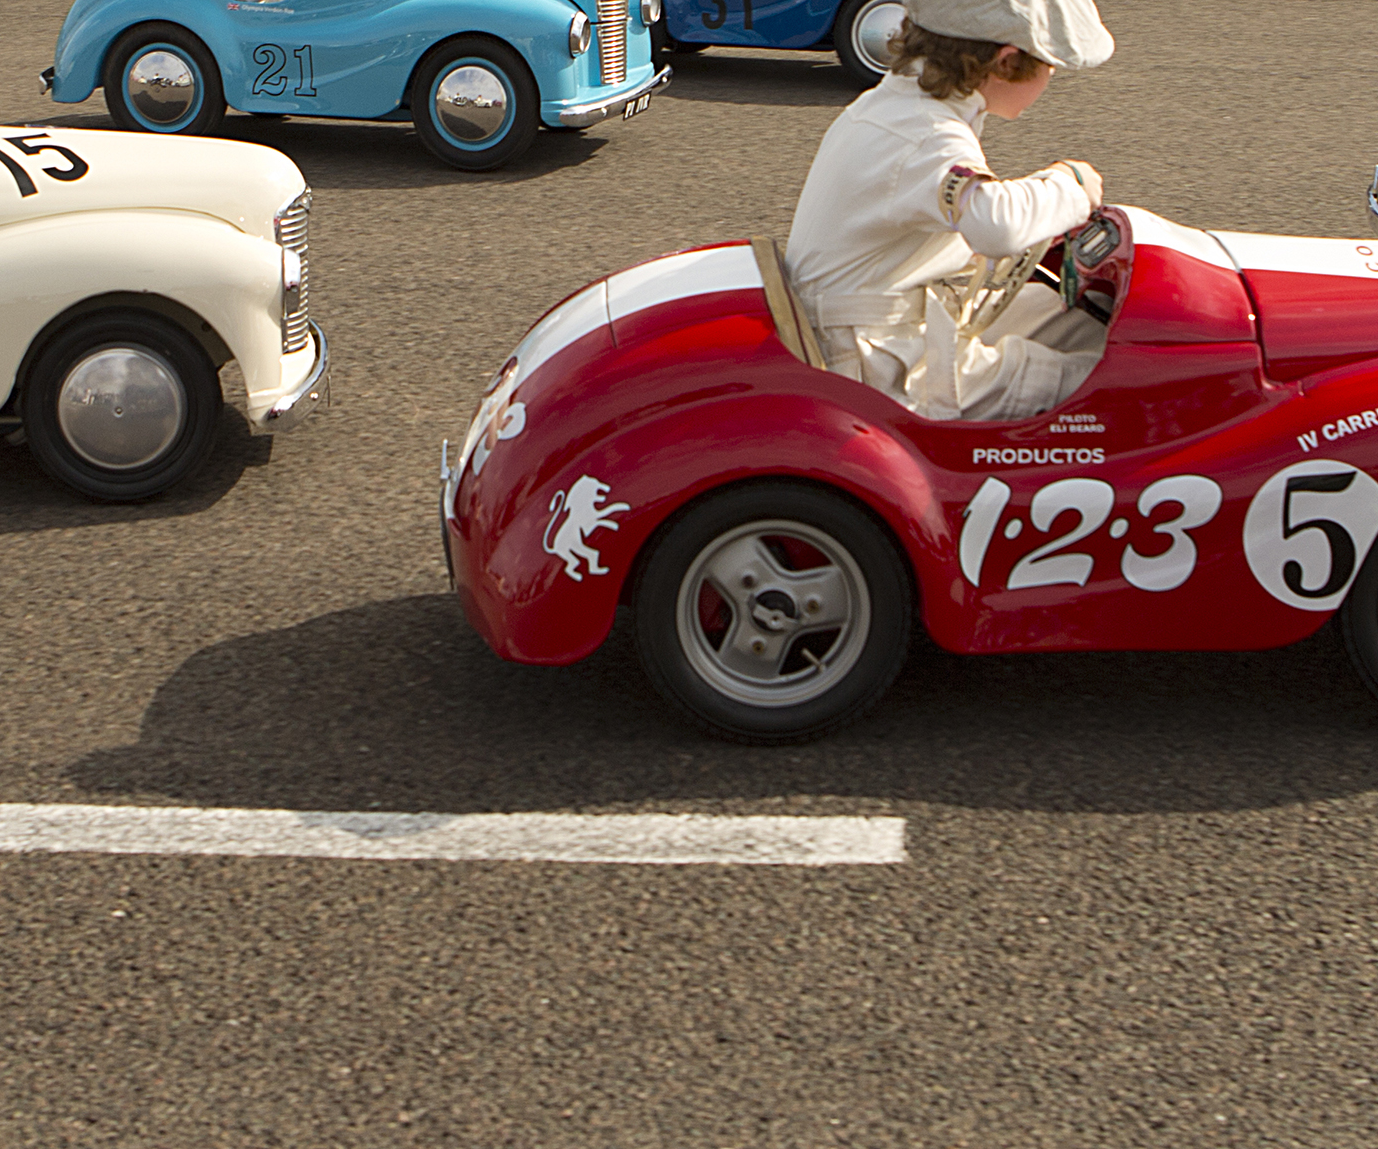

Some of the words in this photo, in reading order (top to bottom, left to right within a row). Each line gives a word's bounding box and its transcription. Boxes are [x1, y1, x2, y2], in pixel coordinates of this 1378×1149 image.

[252, 43, 317, 97] 21
[1049, 423, 1068, 433] ELI
[1068, 423, 1106, 433] BEARD
[1058, 414, 1097, 423] PILOTO
[1297, 430, 1319, 453] IV
[972, 447, 1106, 465] PRODUCTOS
[1282, 470, 1358, 599] 5
